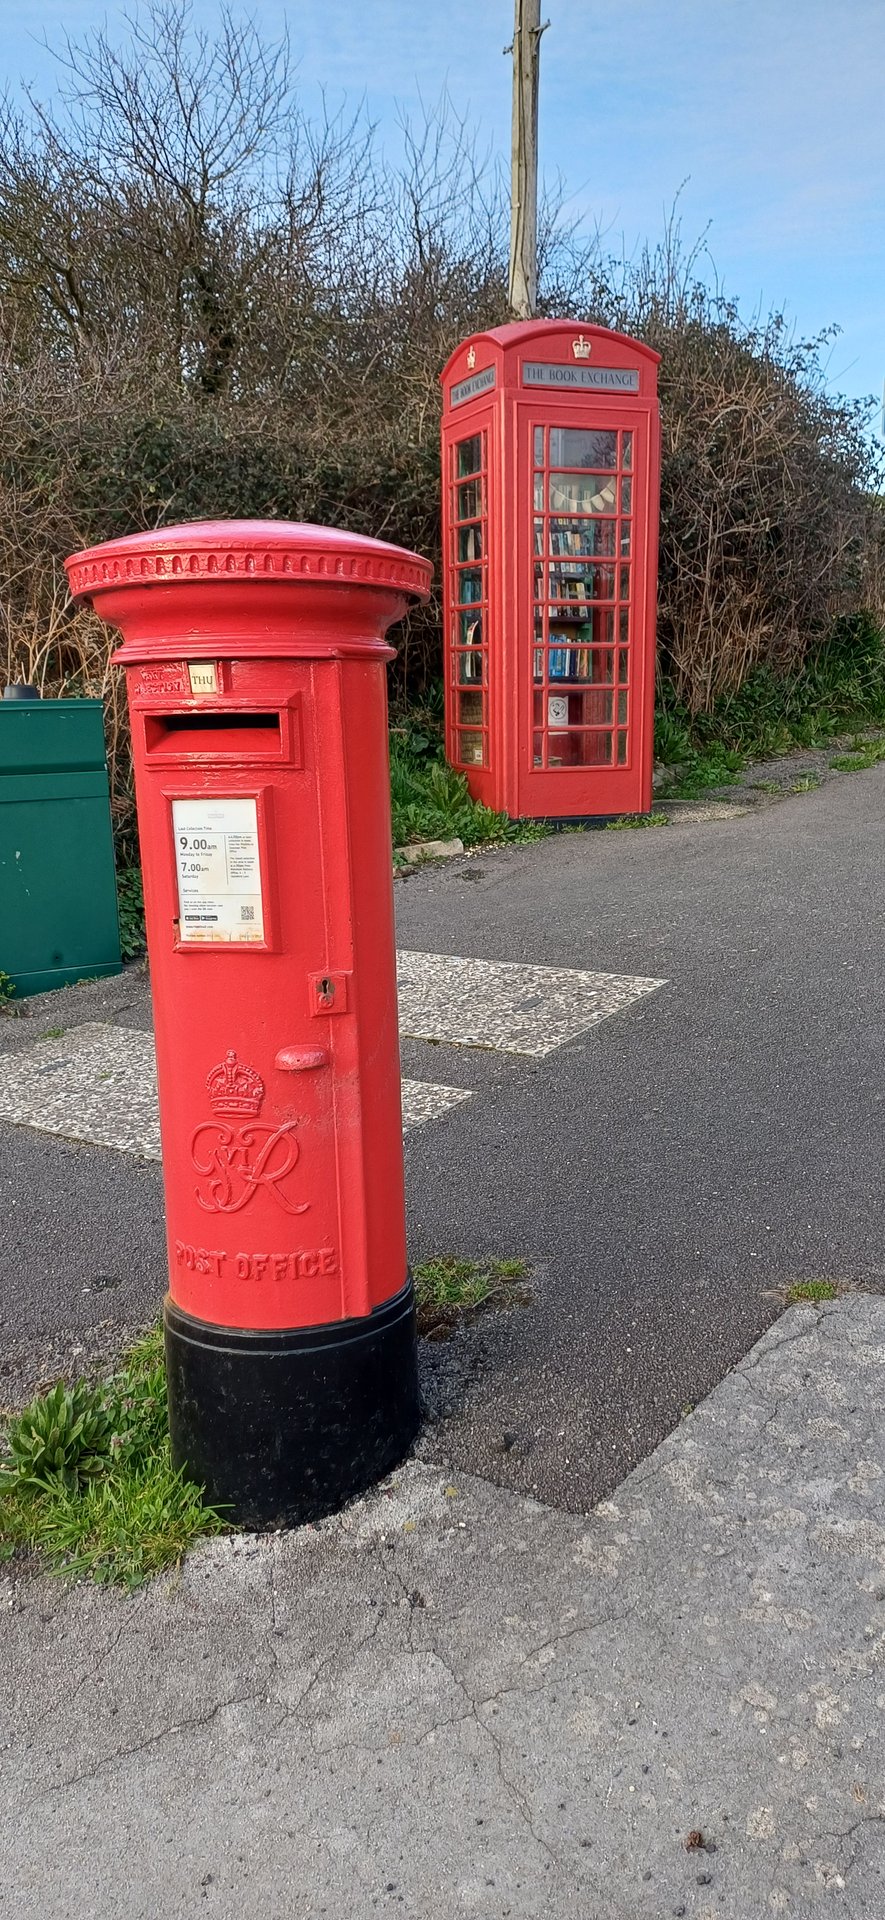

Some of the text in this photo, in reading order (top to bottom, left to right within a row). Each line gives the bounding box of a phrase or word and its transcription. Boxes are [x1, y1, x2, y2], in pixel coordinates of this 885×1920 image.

[527, 367, 636, 386] THE BOOK EXCHANGE
[192, 675, 213, 685] THU
[180, 836, 217, 850] 9.00am
[181, 862, 210, 872] 7.00am
[174, 1239, 340, 1282] POST OFFICE
